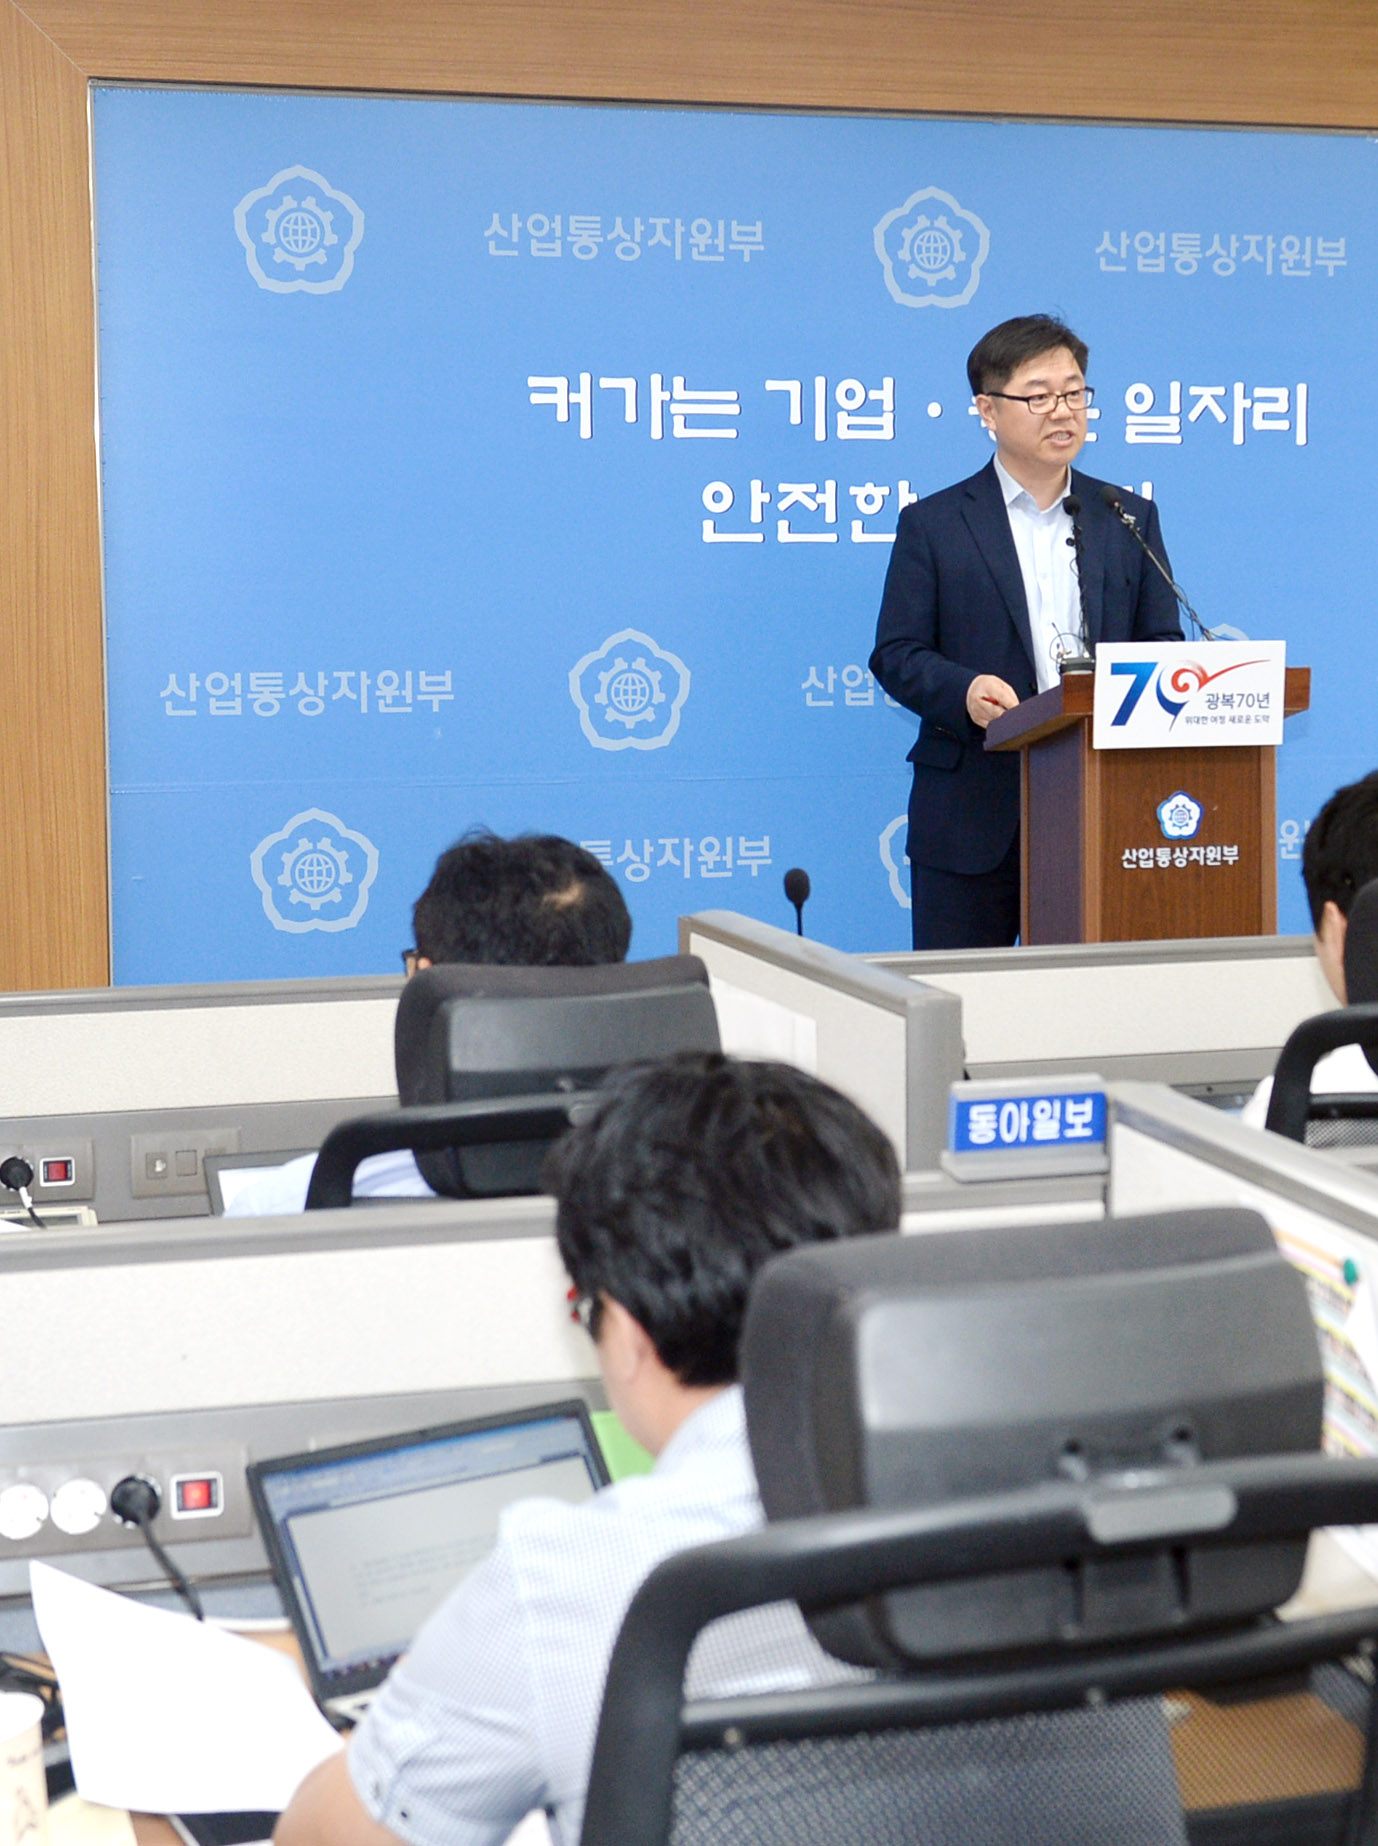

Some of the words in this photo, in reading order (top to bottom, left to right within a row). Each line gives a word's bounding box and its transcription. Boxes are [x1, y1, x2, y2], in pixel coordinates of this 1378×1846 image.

[483, 212, 765, 263] 산업통상자원부
[1094, 229, 1348, 278] 산업통상자원부
[527, 372, 741, 440] 커가는
[764, 375, 895, 441] 기업
[1124, 380, 1308, 446] 일자리
[702, 479, 919, 544] 안전한
[159, 669, 455, 717] 산업통상자원부
[1205, 692, 1271, 711] 광복70년
[1121, 844, 1240, 870] 산업통상자원부
[968, 1097, 1094, 1145] 동아일보
